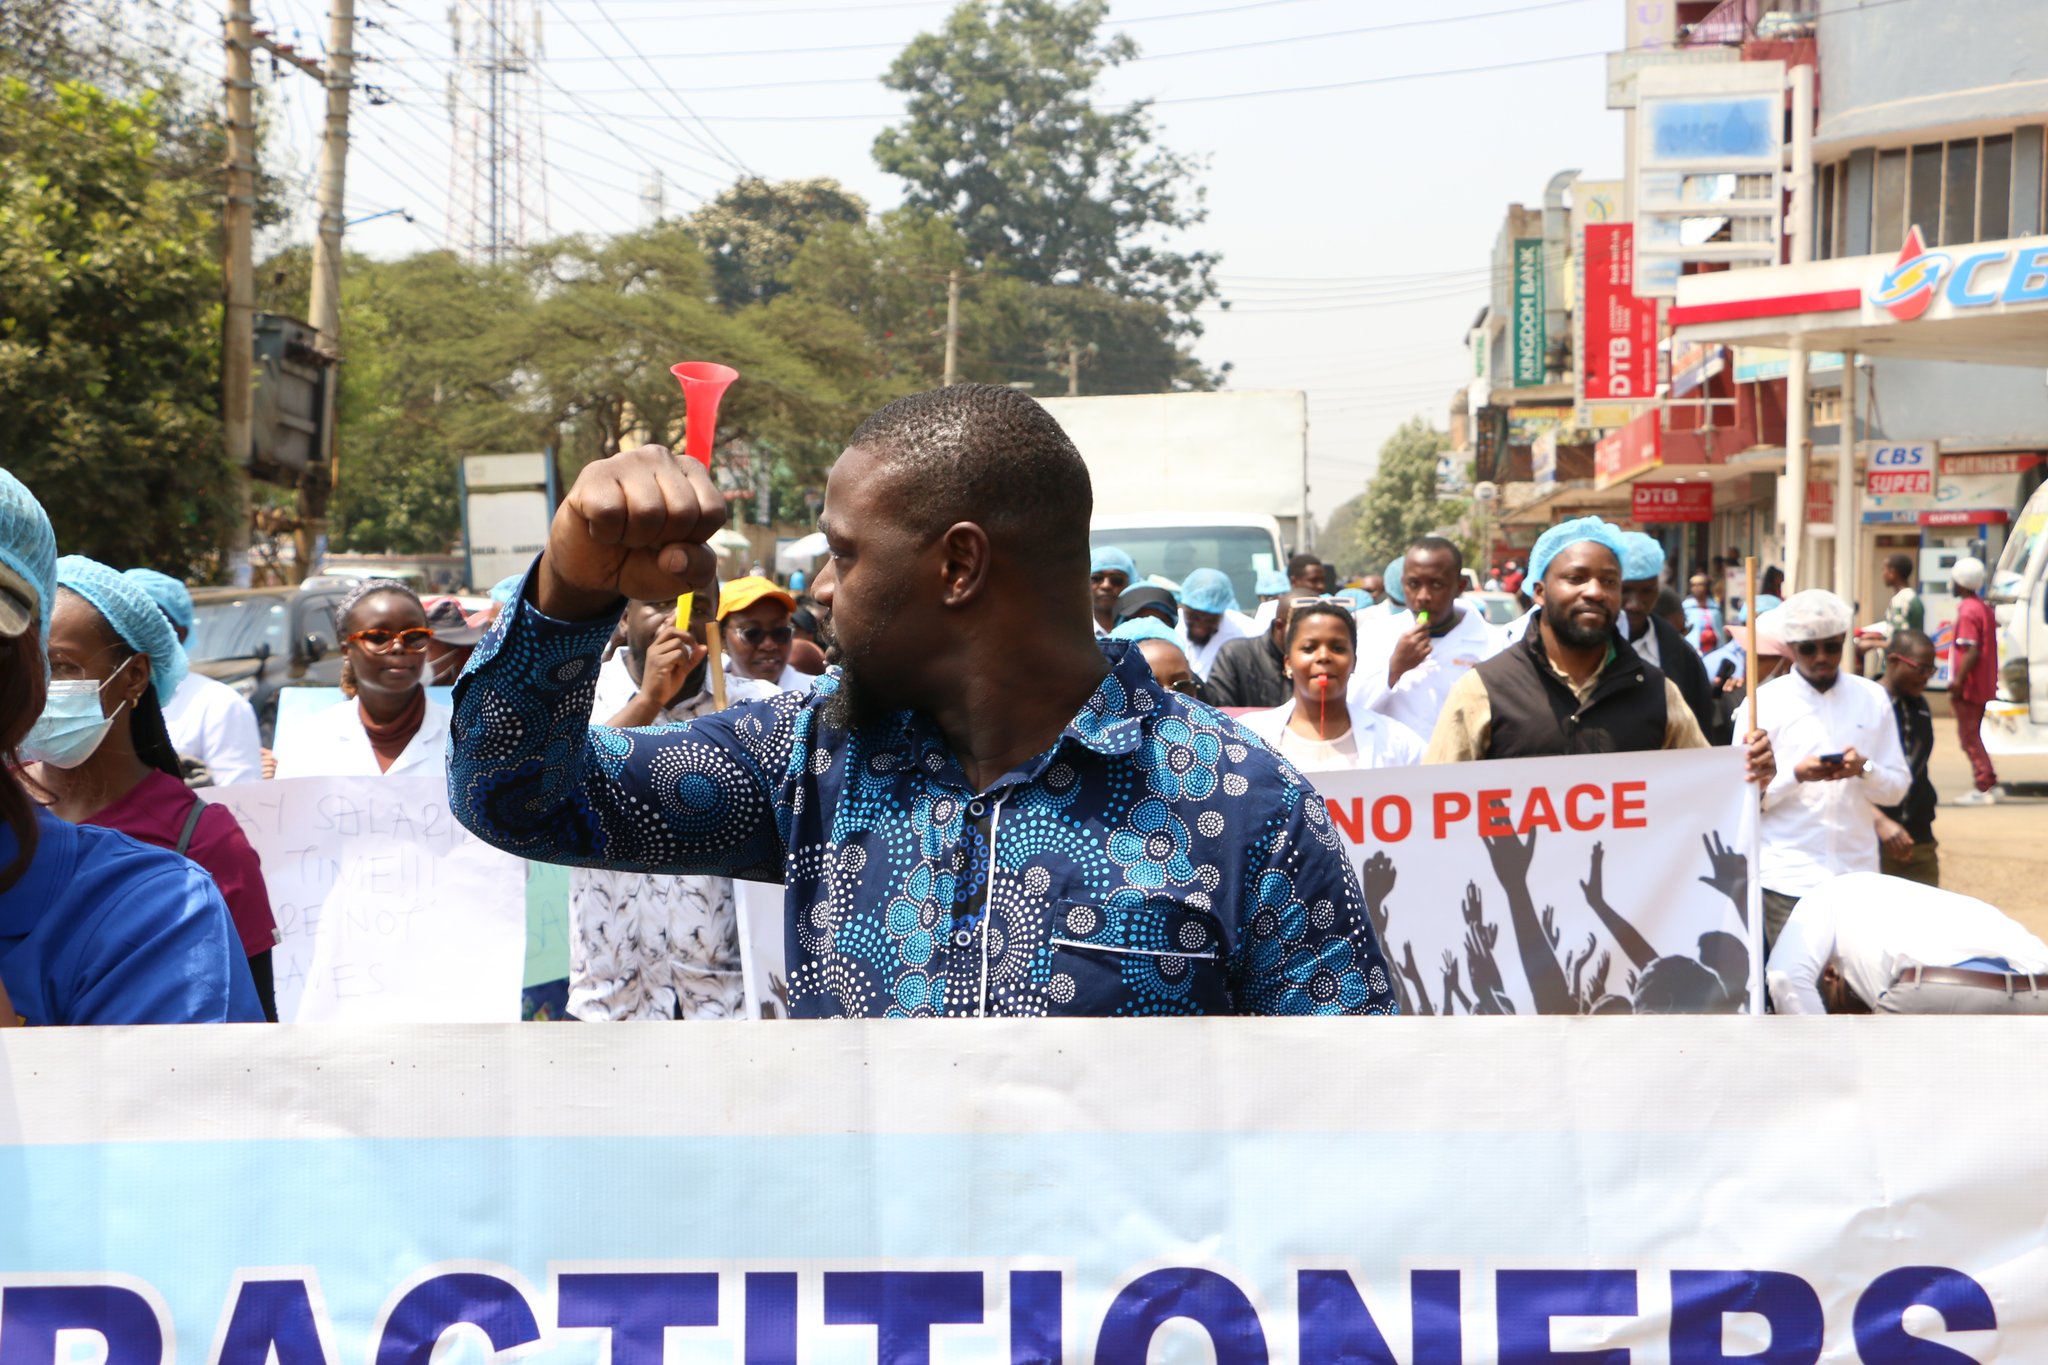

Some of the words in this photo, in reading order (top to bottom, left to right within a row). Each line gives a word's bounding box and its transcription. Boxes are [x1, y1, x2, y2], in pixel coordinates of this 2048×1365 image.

[1519, 247, 1534, 295] BANK
[1519, 297, 1534, 380] KINGDOM
[1609, 337, 1631, 396] DTB
[1875, 447, 1924, 465] CBS
[1943, 455, 2017, 474] CHEMIST
[1635, 488, 1678, 504] DTB
[1869, 474, 1928, 493] SUPER
[1325, 794, 1412, 845] NO
[1433, 780, 1648, 840] PEACE
[345, 904, 425, 944] NOT
